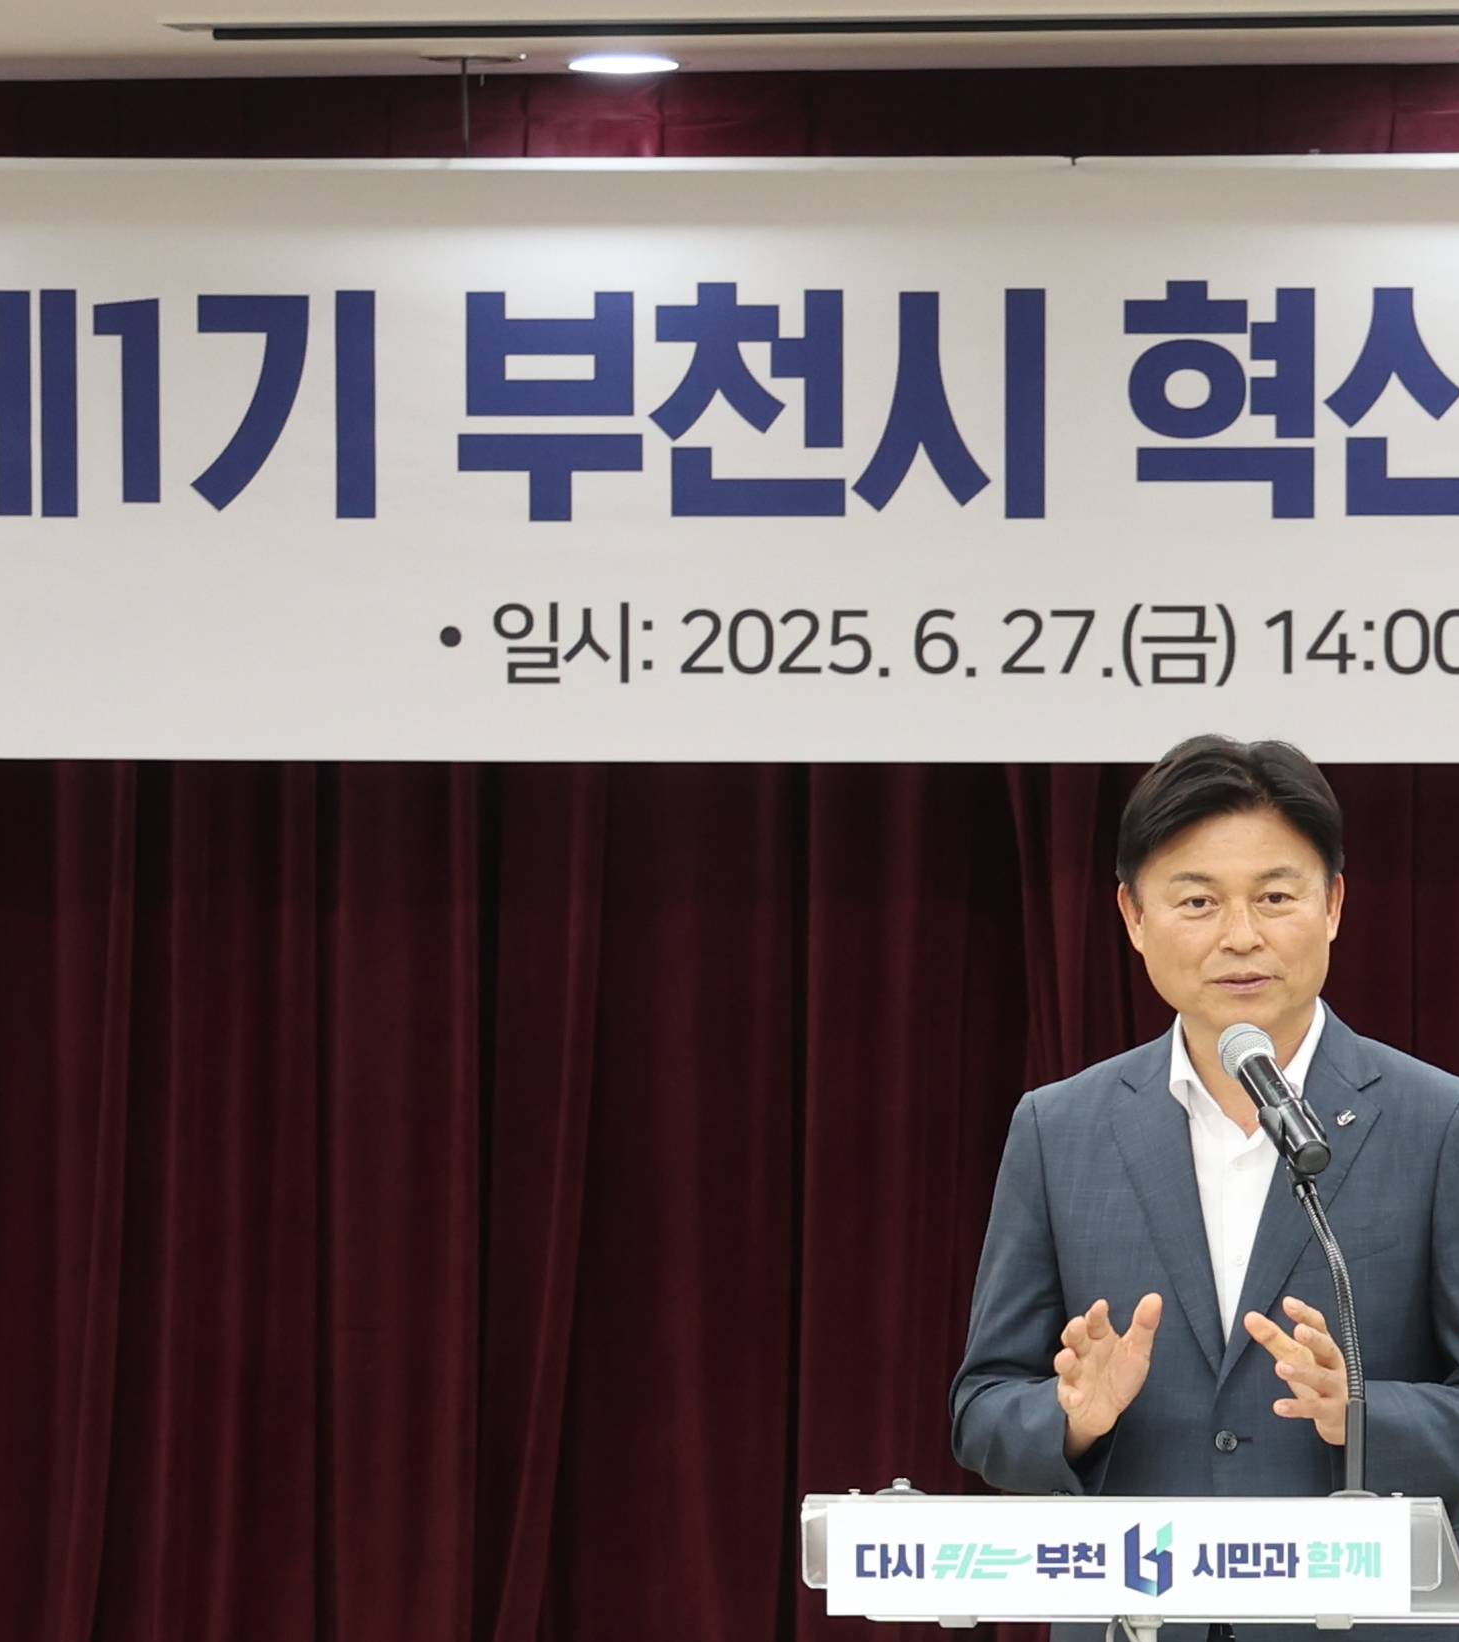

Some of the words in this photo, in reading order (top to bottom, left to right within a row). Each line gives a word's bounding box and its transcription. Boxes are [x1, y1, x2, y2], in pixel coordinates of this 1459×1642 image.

[456, 281, 1046, 522] 부천시
[492, 600, 653, 684] 일시:
[679, 607, 890, 678] 2025.
[913, 607, 976, 678] 6.
[854, 1542, 925, 1580] 다시
[931, 1541, 1033, 1580] 뛰는
[1035, 1541, 1107, 1580] 부천
[1191, 1541, 1301, 1579] 시민과
[1306, 1540, 1383, 1580] 함께
